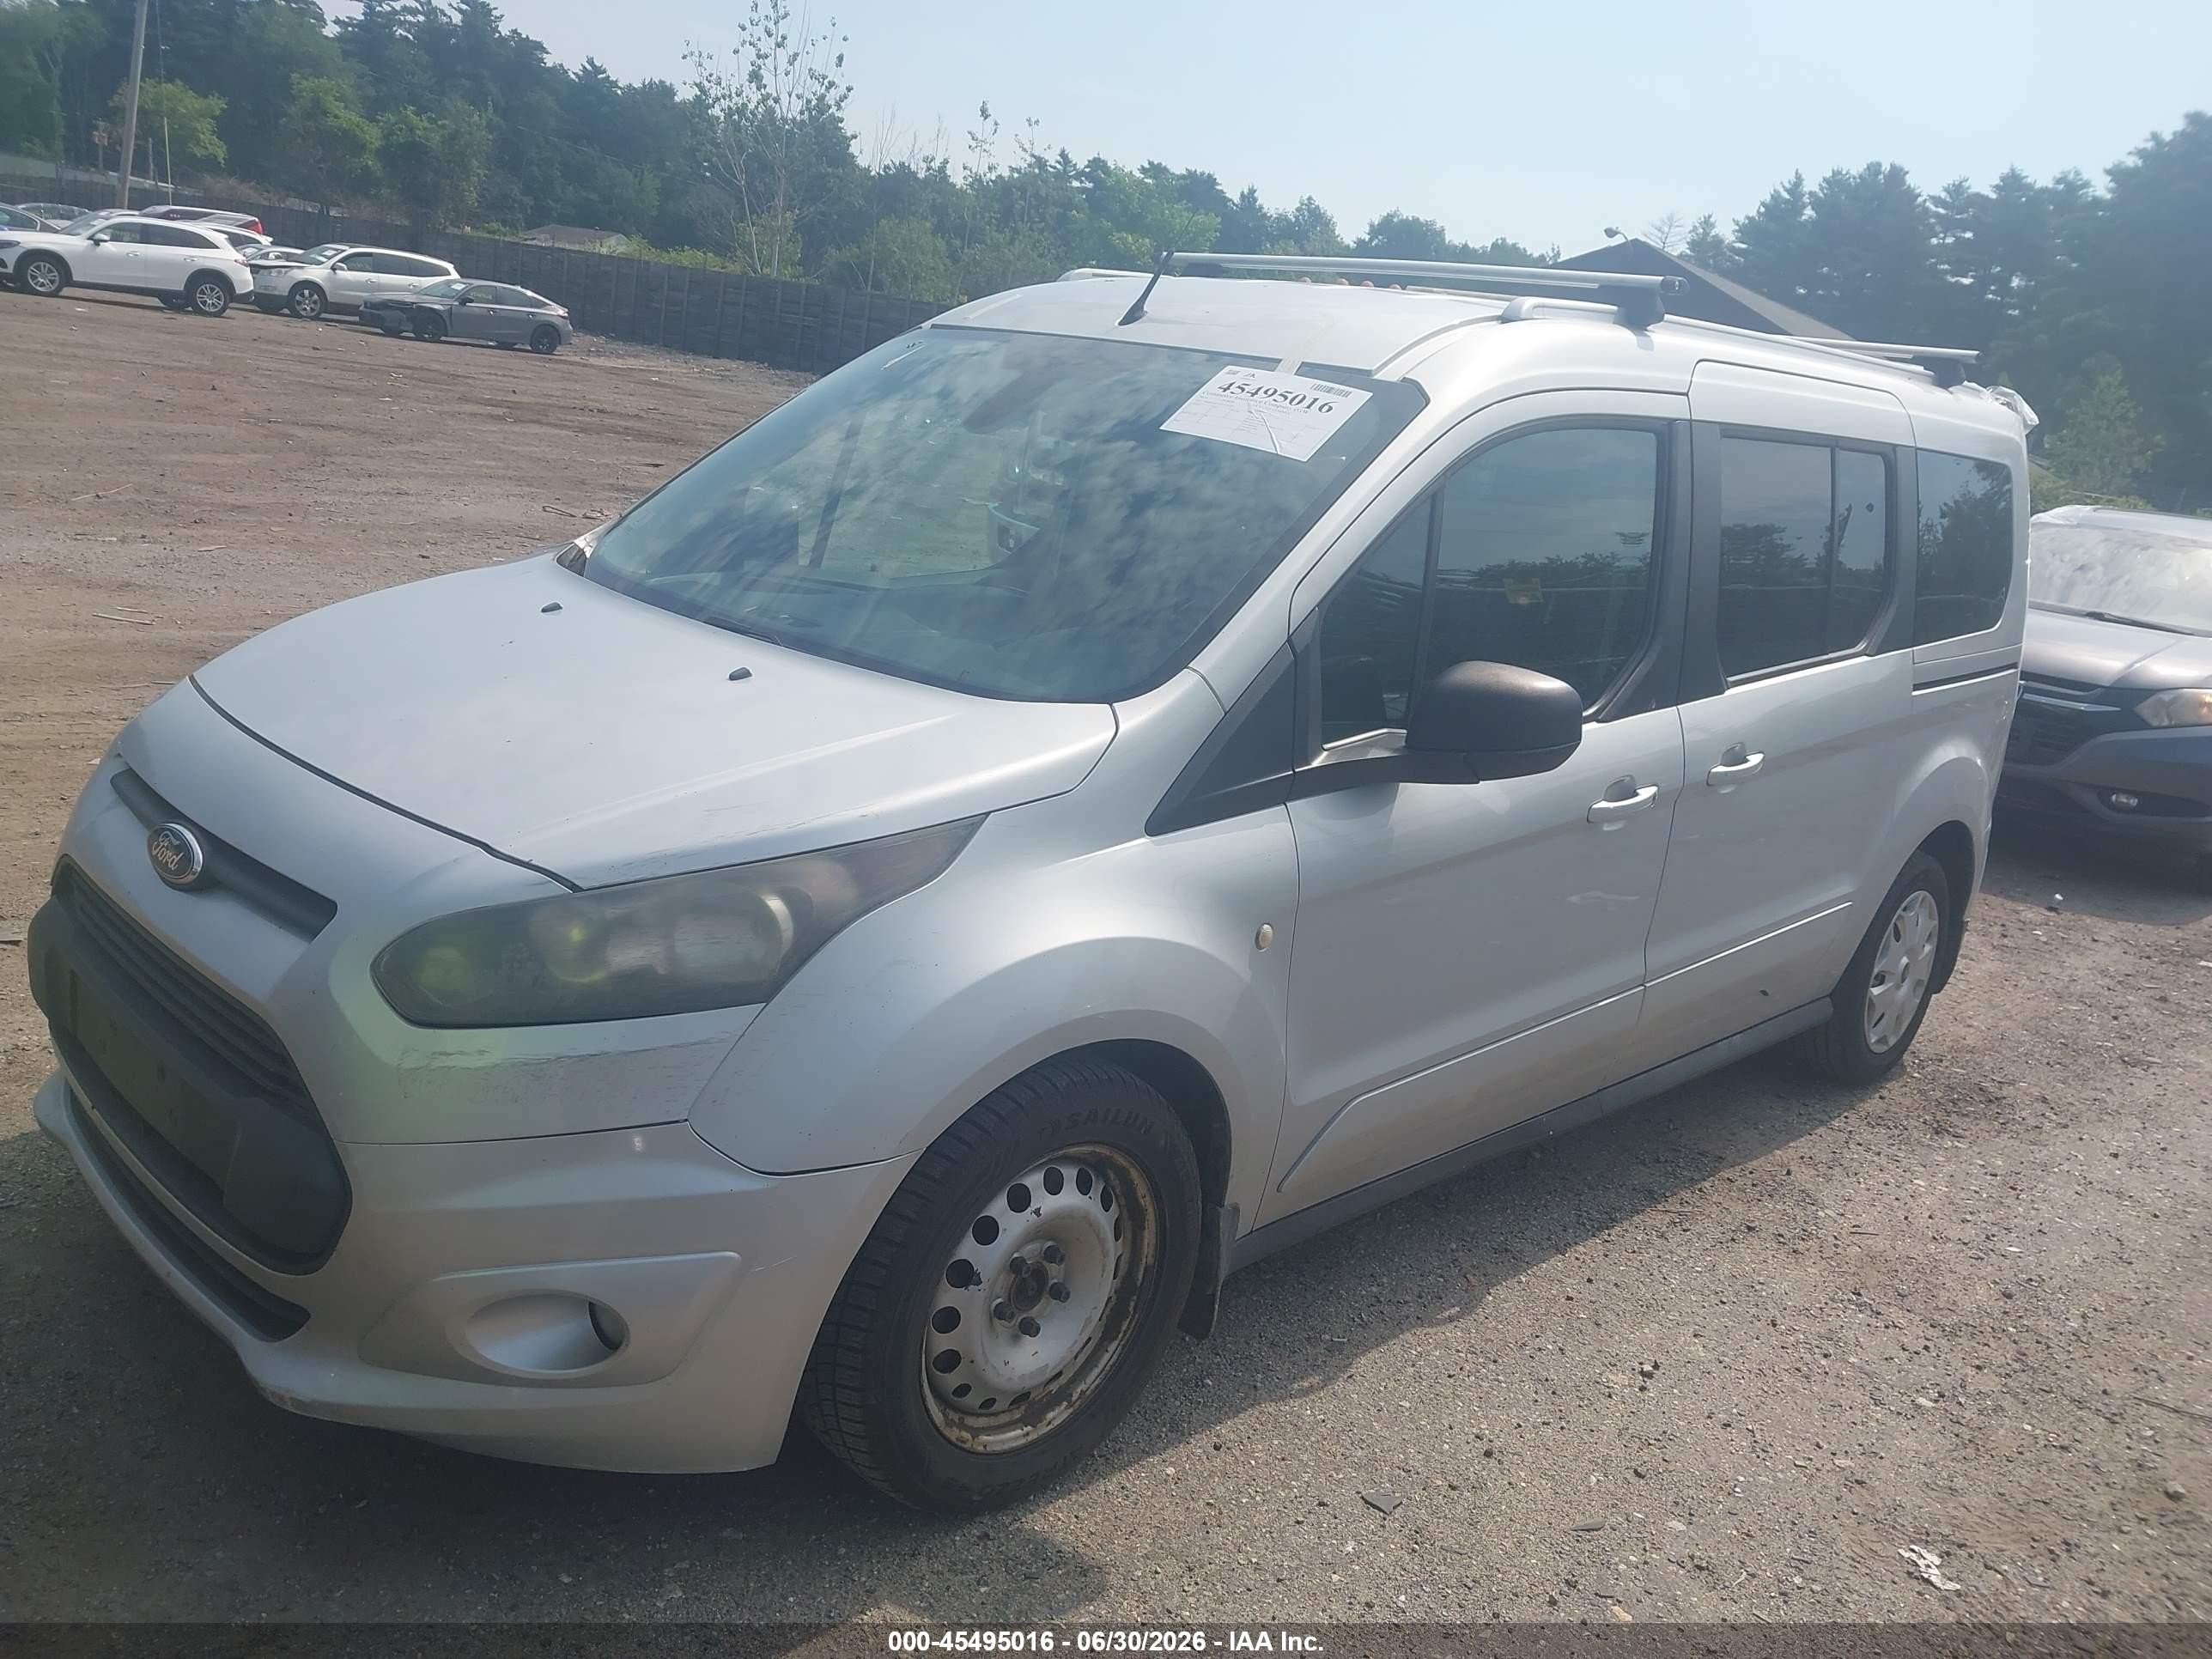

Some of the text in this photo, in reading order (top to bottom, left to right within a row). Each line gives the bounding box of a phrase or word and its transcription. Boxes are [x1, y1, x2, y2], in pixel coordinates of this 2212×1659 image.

[1218, 380, 1340, 414] 45495016
[152, 830, 184, 870] Ford
[1065, 1107, 1154, 1134] SAILUN
